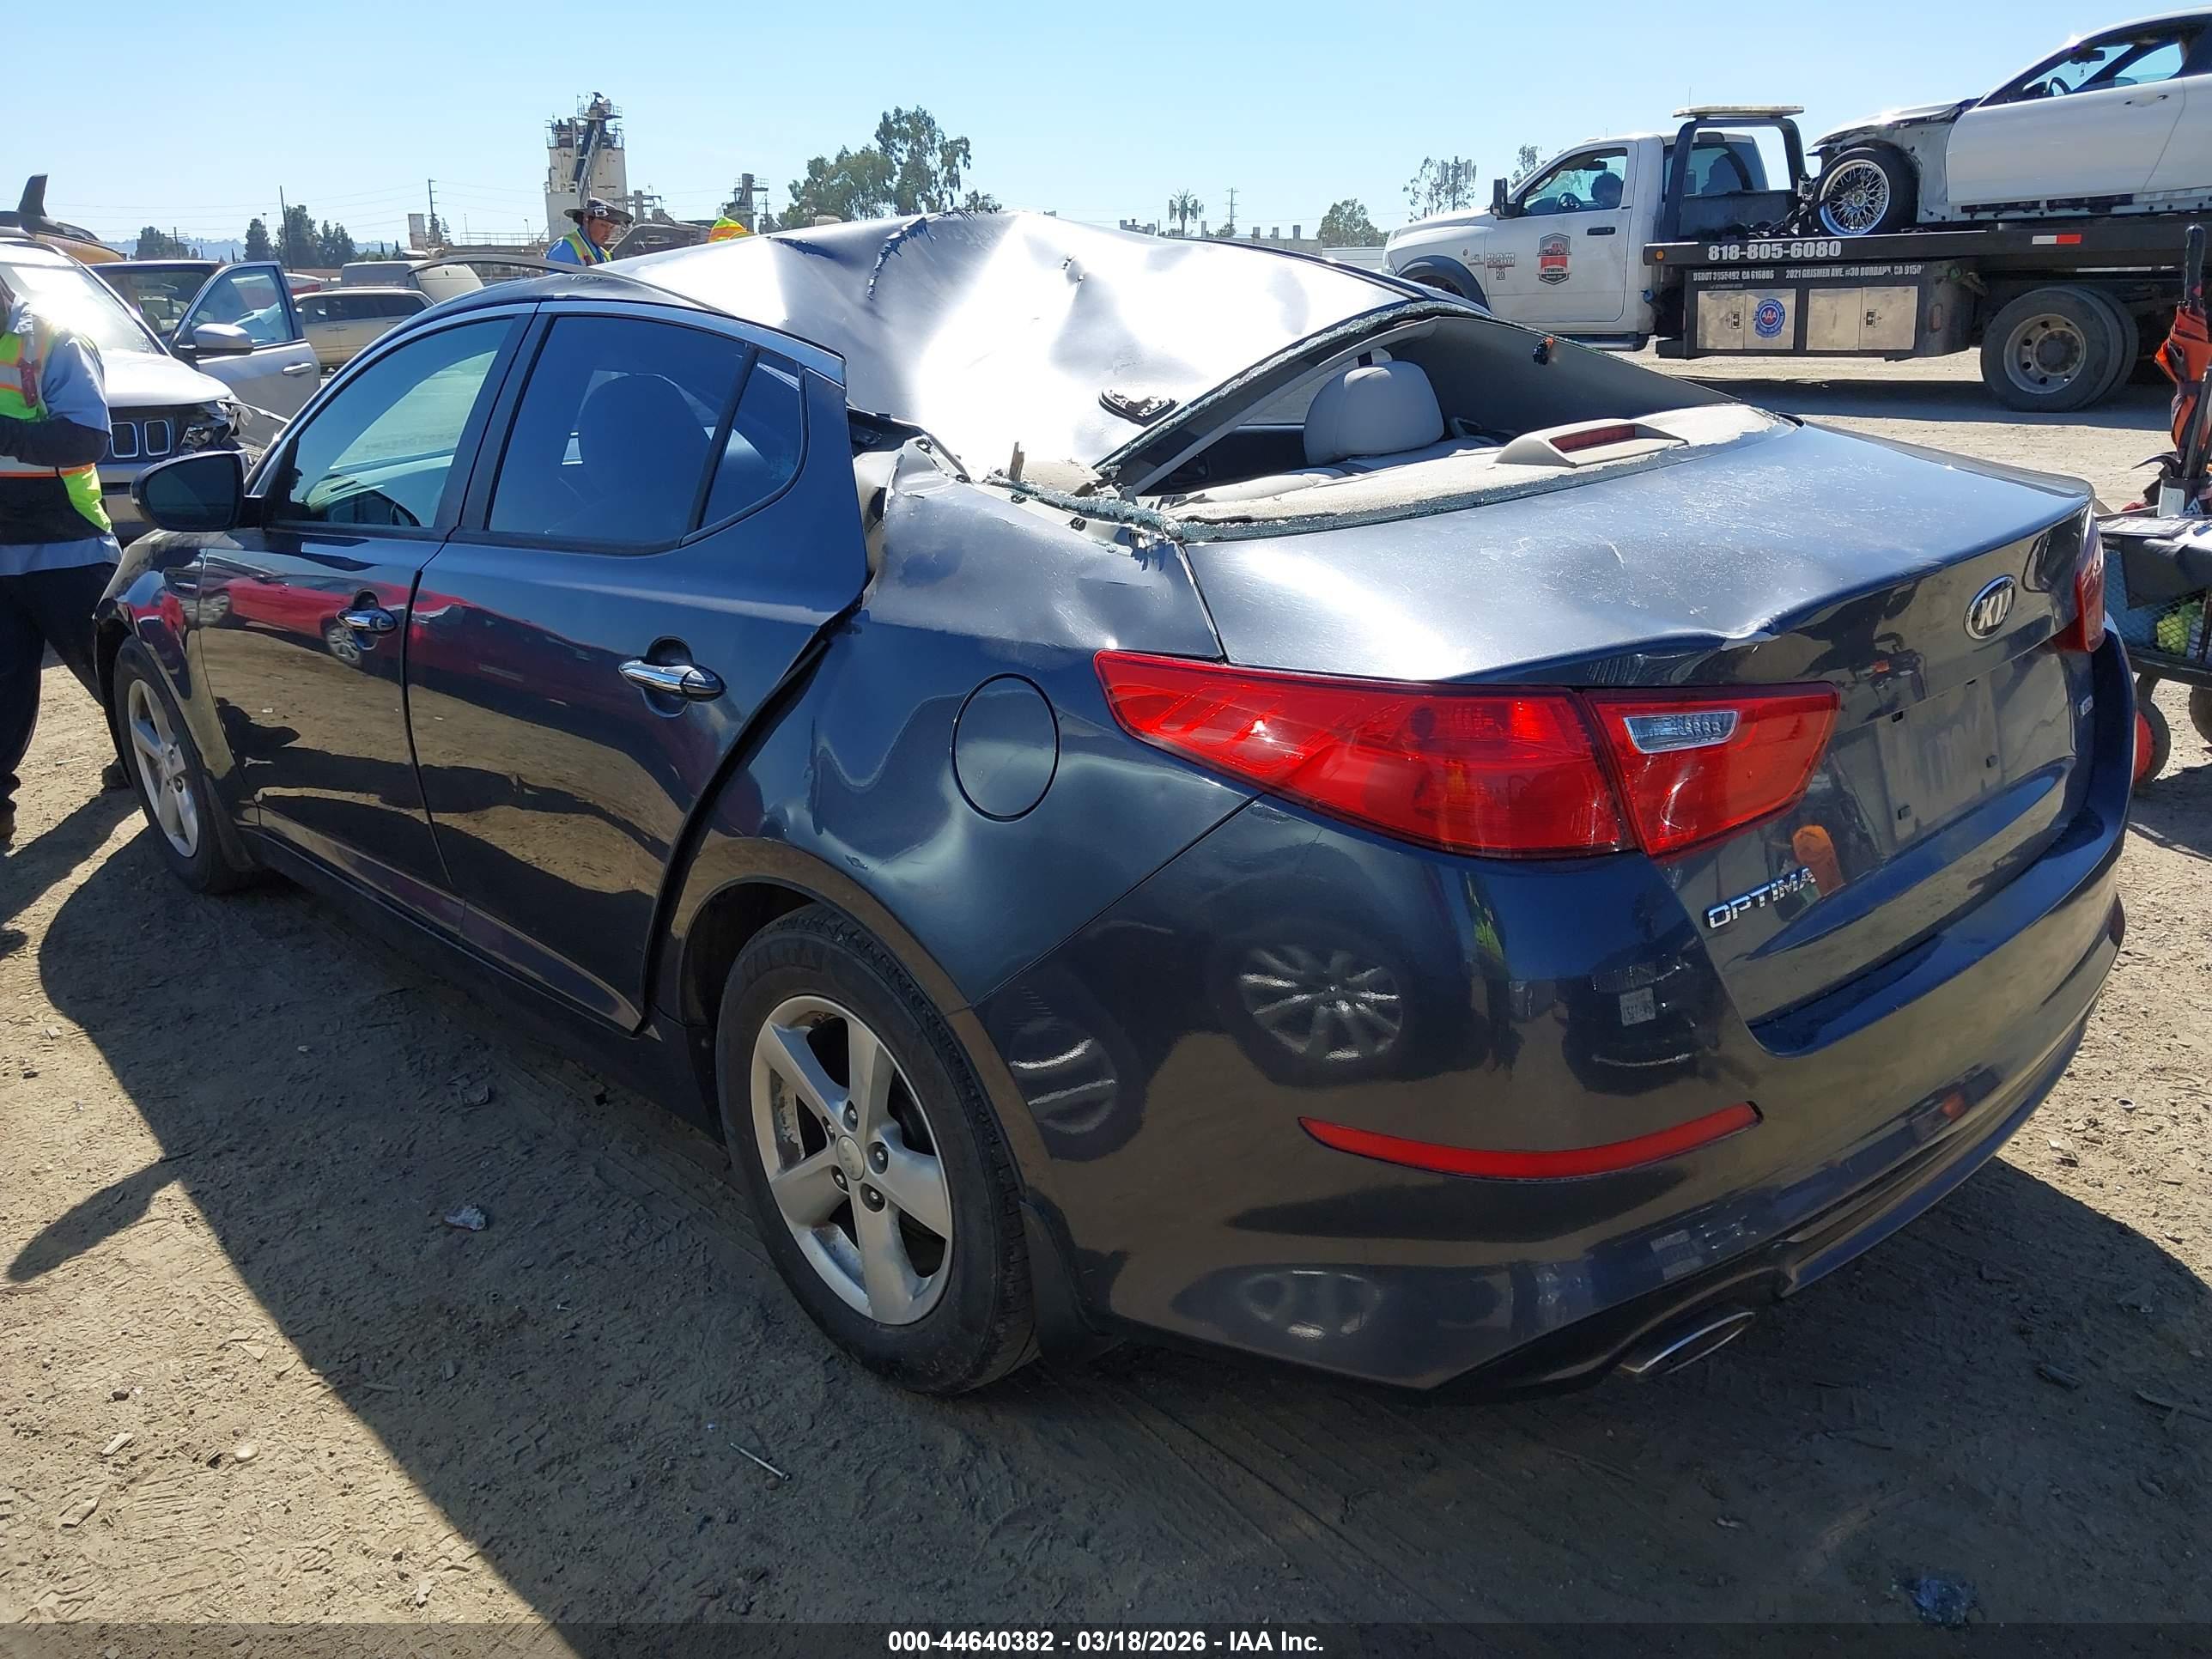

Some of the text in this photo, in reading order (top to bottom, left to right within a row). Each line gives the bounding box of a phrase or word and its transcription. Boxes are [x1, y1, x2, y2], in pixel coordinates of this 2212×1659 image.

[1486, 252, 1515, 265] RAM
[1708, 241, 1842, 261] 818-805-6080
[1786, 269, 1802, 278] 2021
[1761, 309, 1777, 320] AAA
[1978, 587, 2013, 630] KIA
[1706, 866, 1816, 929] OPTIMA
